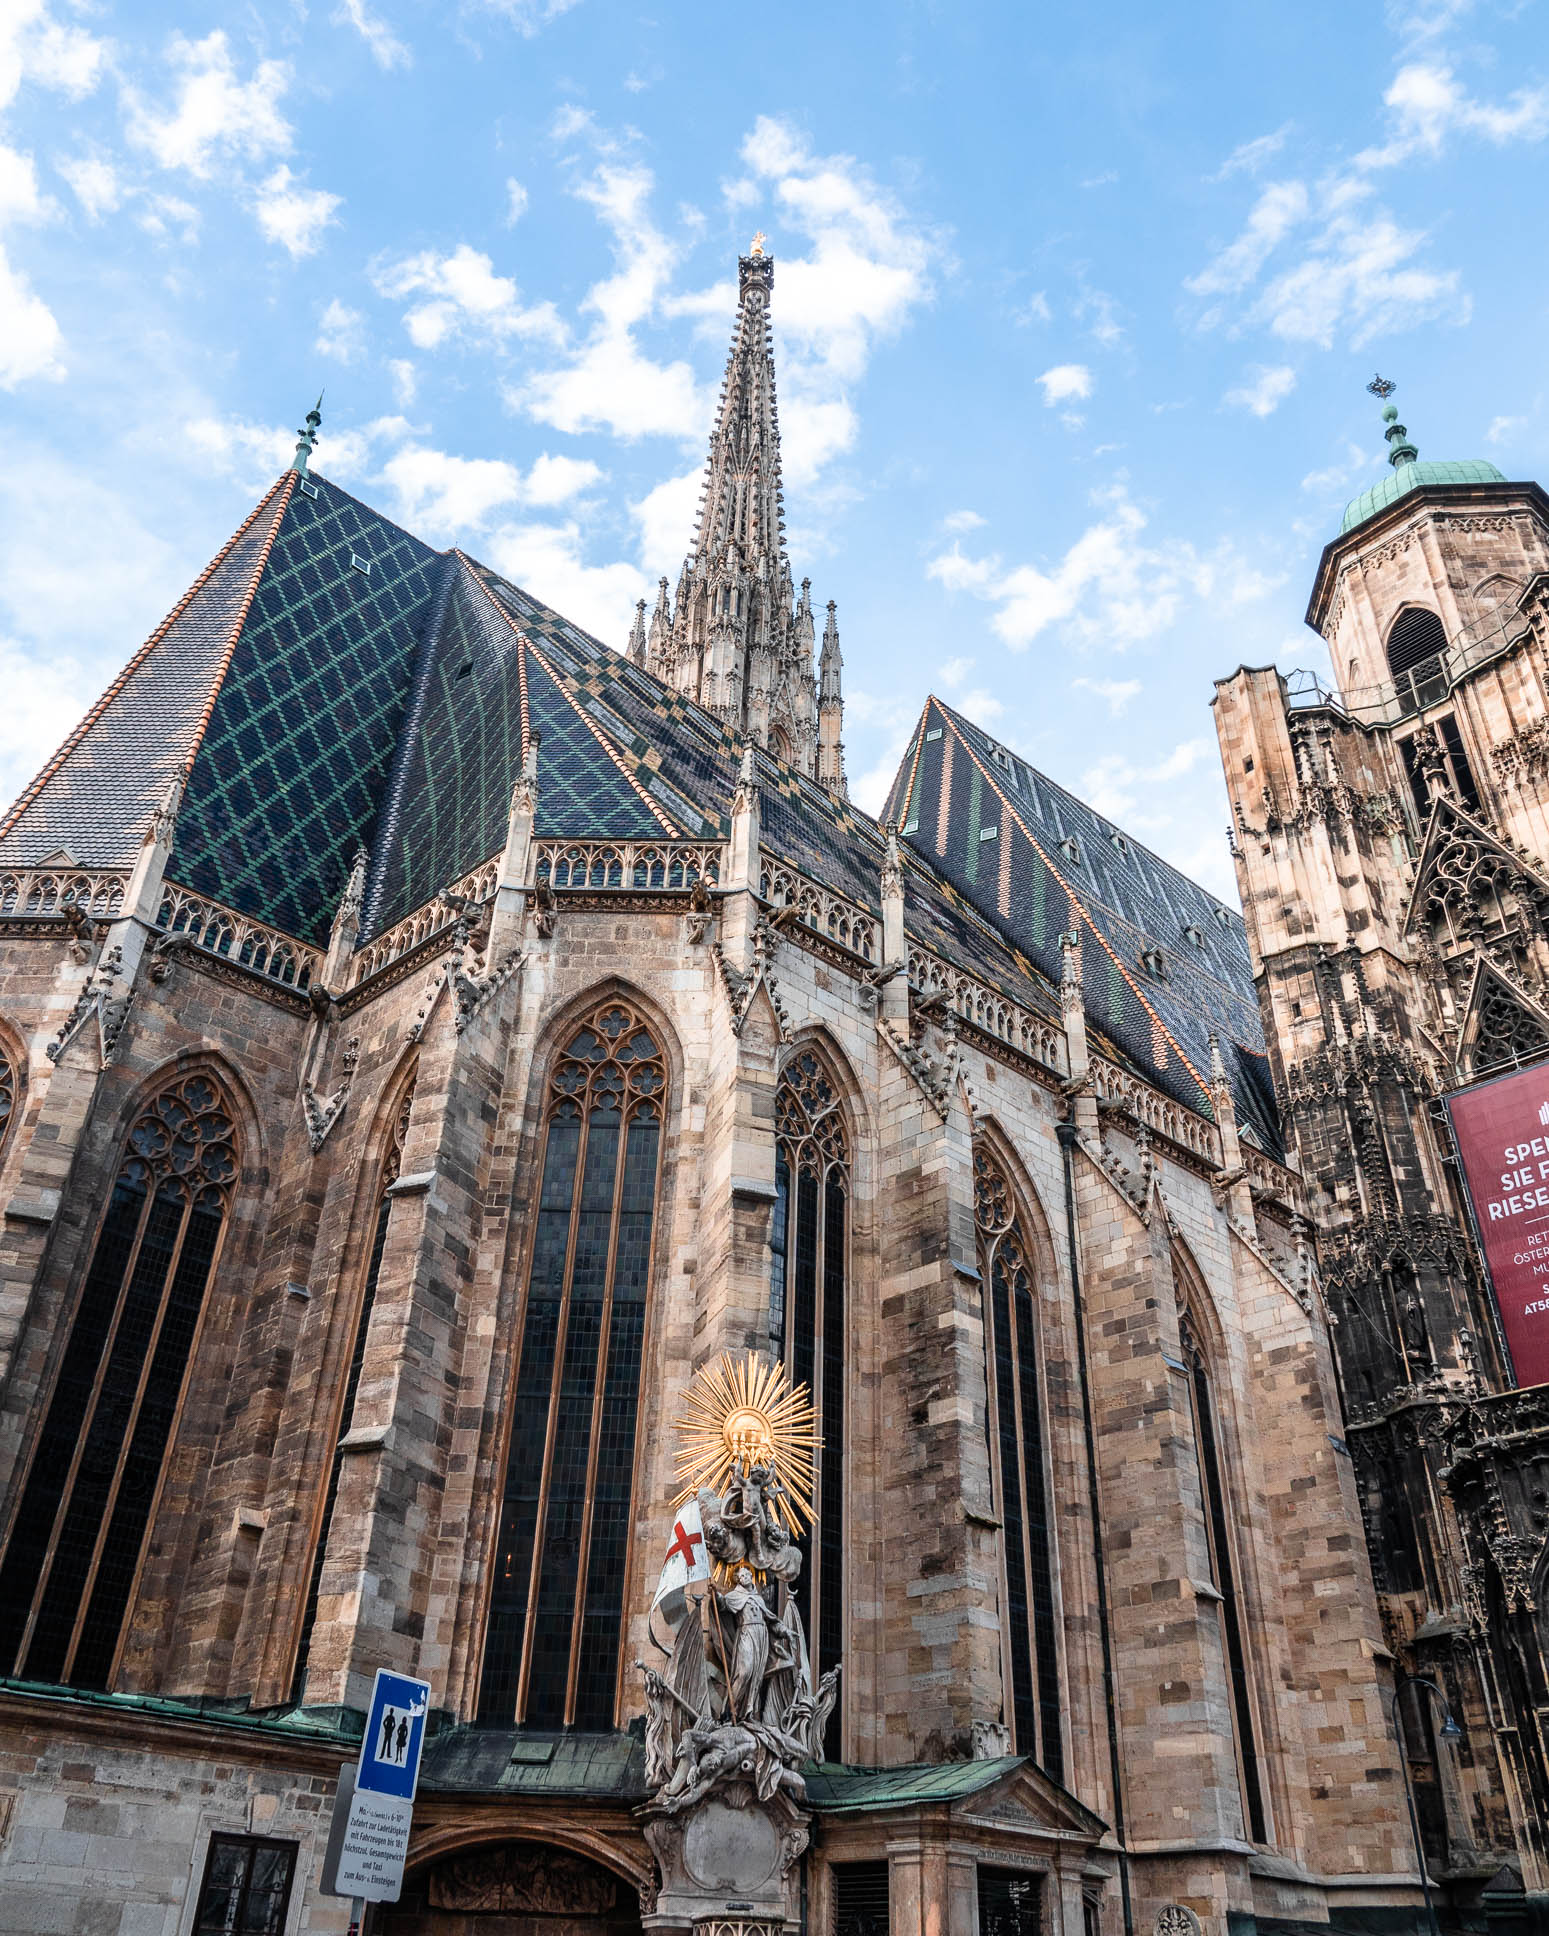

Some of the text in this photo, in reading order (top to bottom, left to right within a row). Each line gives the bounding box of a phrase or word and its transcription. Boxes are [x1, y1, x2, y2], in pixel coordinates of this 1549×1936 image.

[1500, 1166, 1535, 1191] SIE
[1488, 1186, 1549, 1221] RIESE
[350, 1817, 408, 1837] Zufahrt zur Ladetätigkeit
[350, 1832, 359, 1840] mit
[359, 1833, 386, 1846] Fahrzeugen
[387, 1838, 395, 1847] bis
[369, 1847, 405, 1862] Gesamtgewicht
[362, 1861, 383, 1871] und Taxi
[344, 1871, 355, 1880] zum
[370, 1874, 396, 1887] Einsteigen
